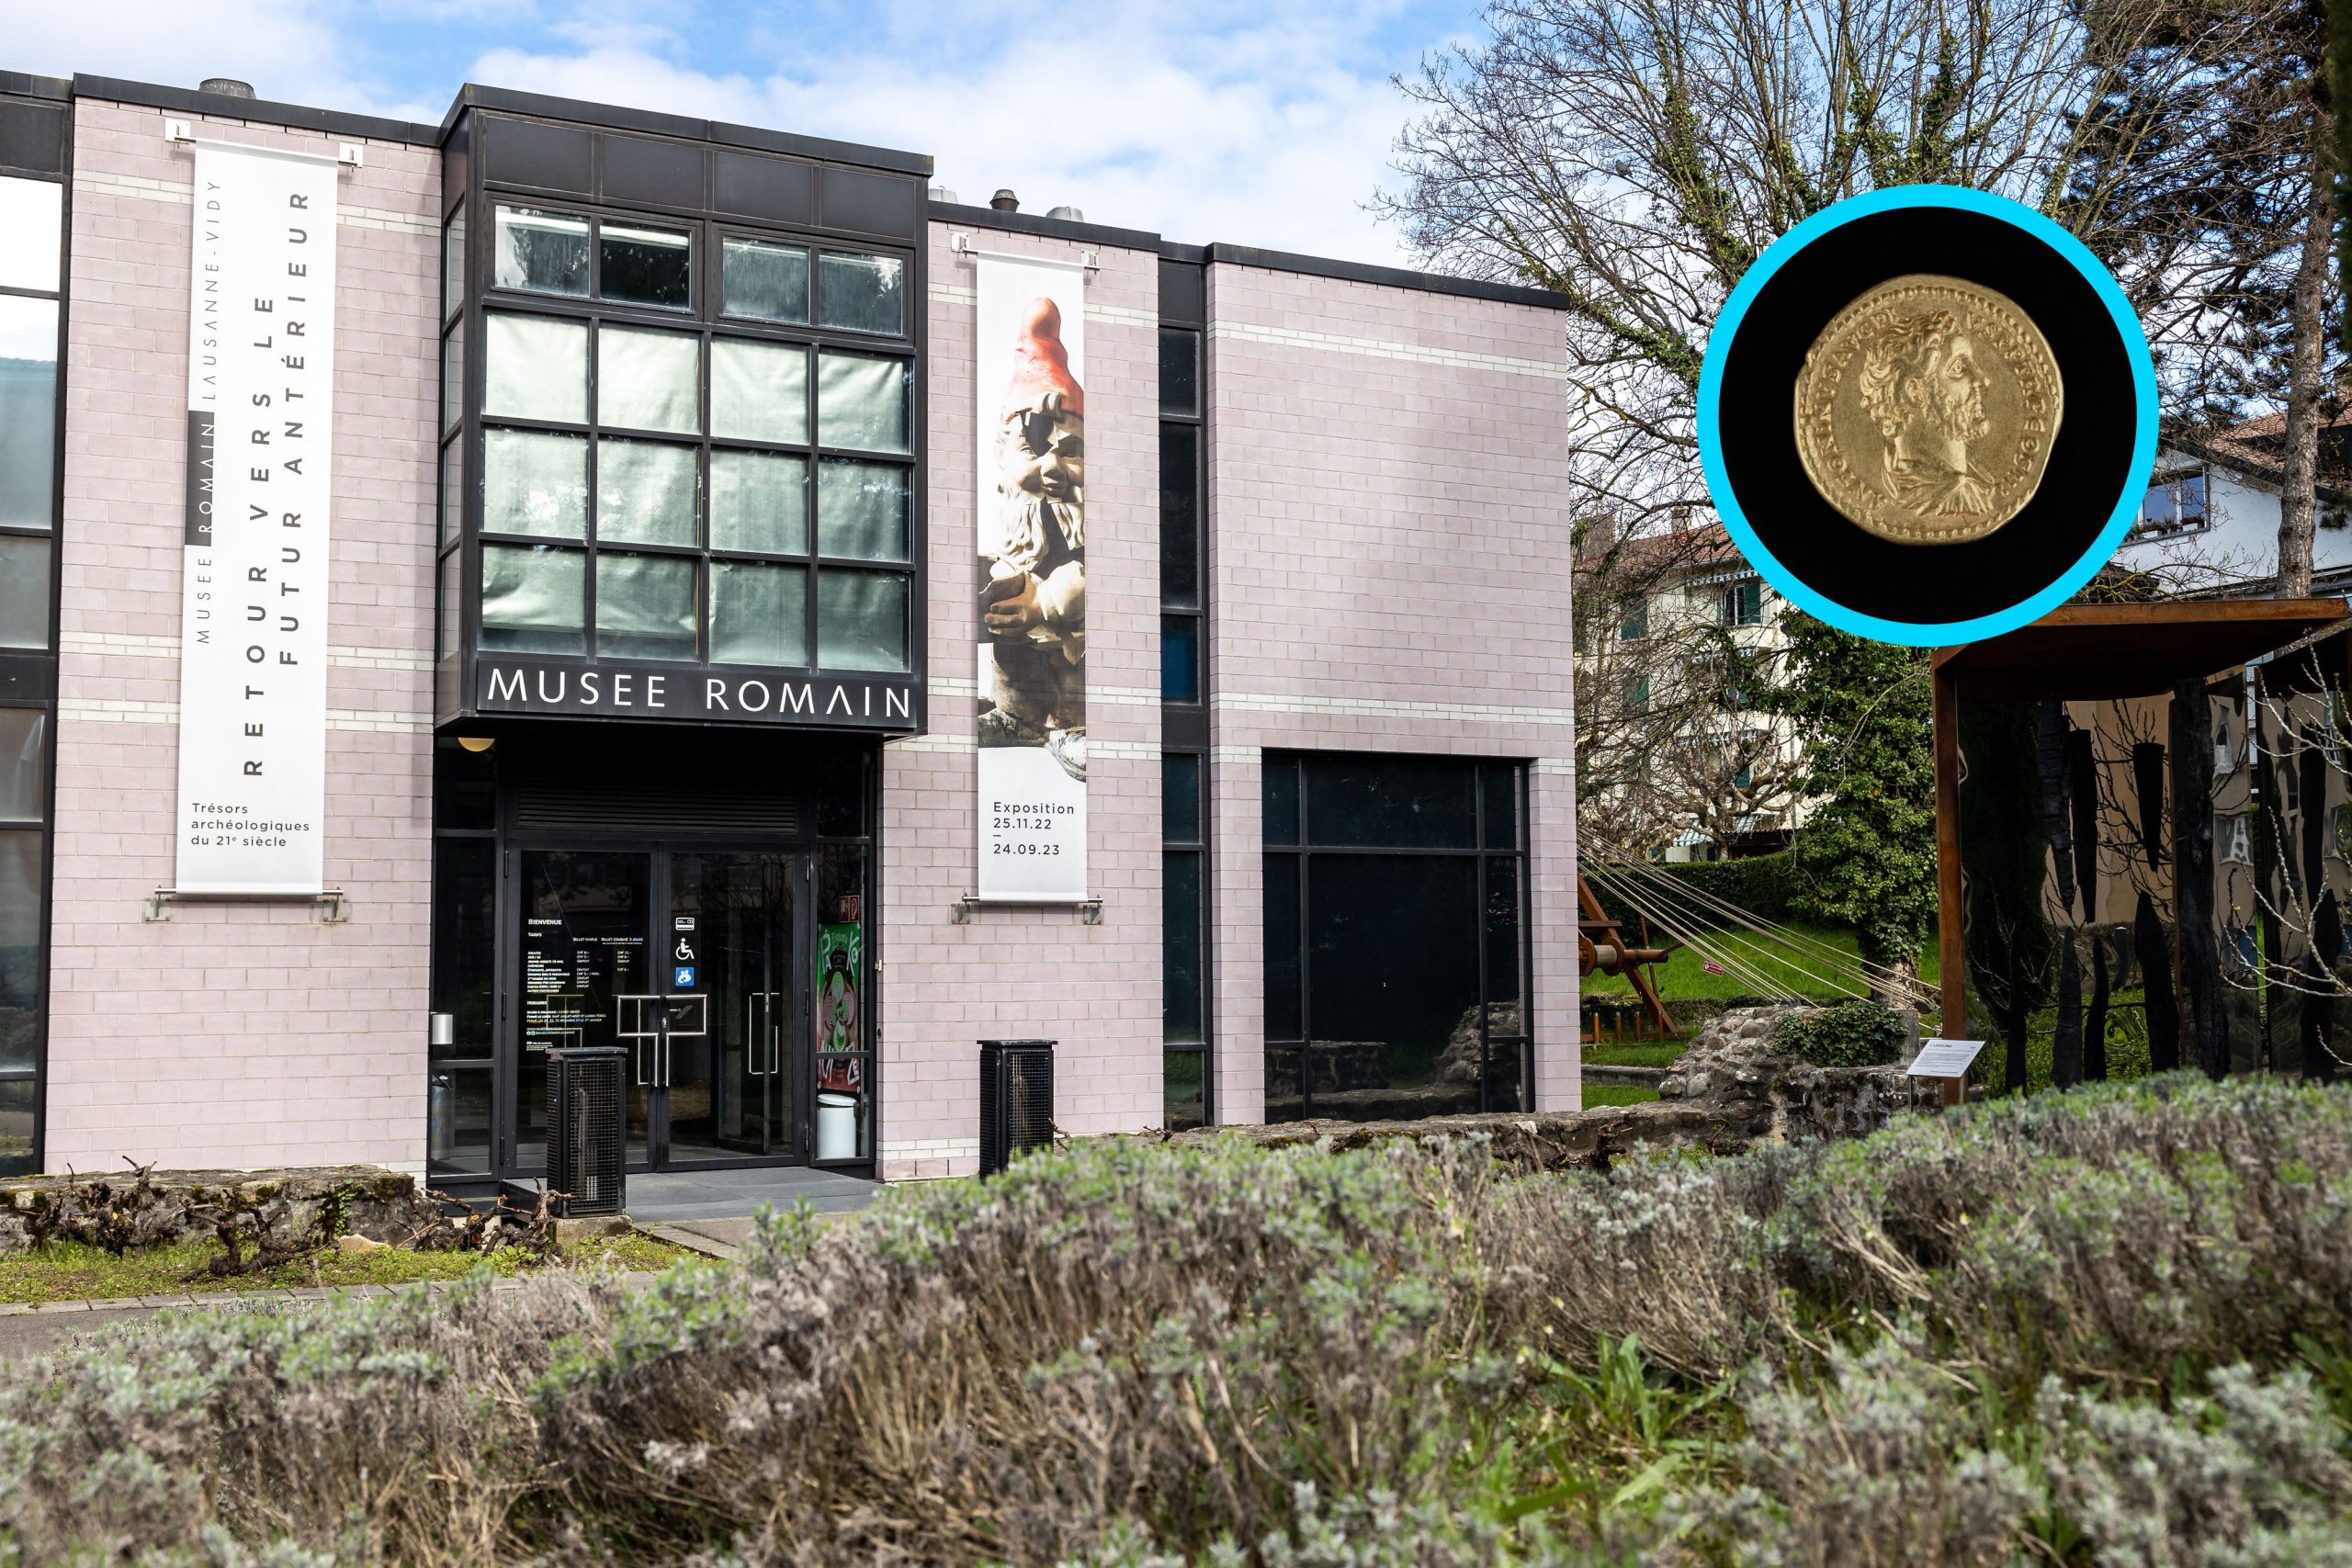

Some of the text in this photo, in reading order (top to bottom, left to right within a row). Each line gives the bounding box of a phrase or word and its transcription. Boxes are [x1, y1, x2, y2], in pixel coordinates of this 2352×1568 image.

[197, 181, 220, 644] MUSEE ROMAIN LAUSANNE-VIDY
[278, 193, 309, 666] FUTUR ANTÉRIEUR
[243, 297, 274, 776] RETOUR VERS LE
[487, 668, 910, 718] MUSEE ROMAIN
[191, 802, 249, 815] Trésors
[993, 801, 1075, 816] Exposition
[190, 818, 311, 833] archéologiques
[993, 818, 1052, 829] 25.11.22
[190, 834, 209, 846] du
[242, 835, 288, 848] siècle
[993, 843, 1060, 855] 24.09.23
